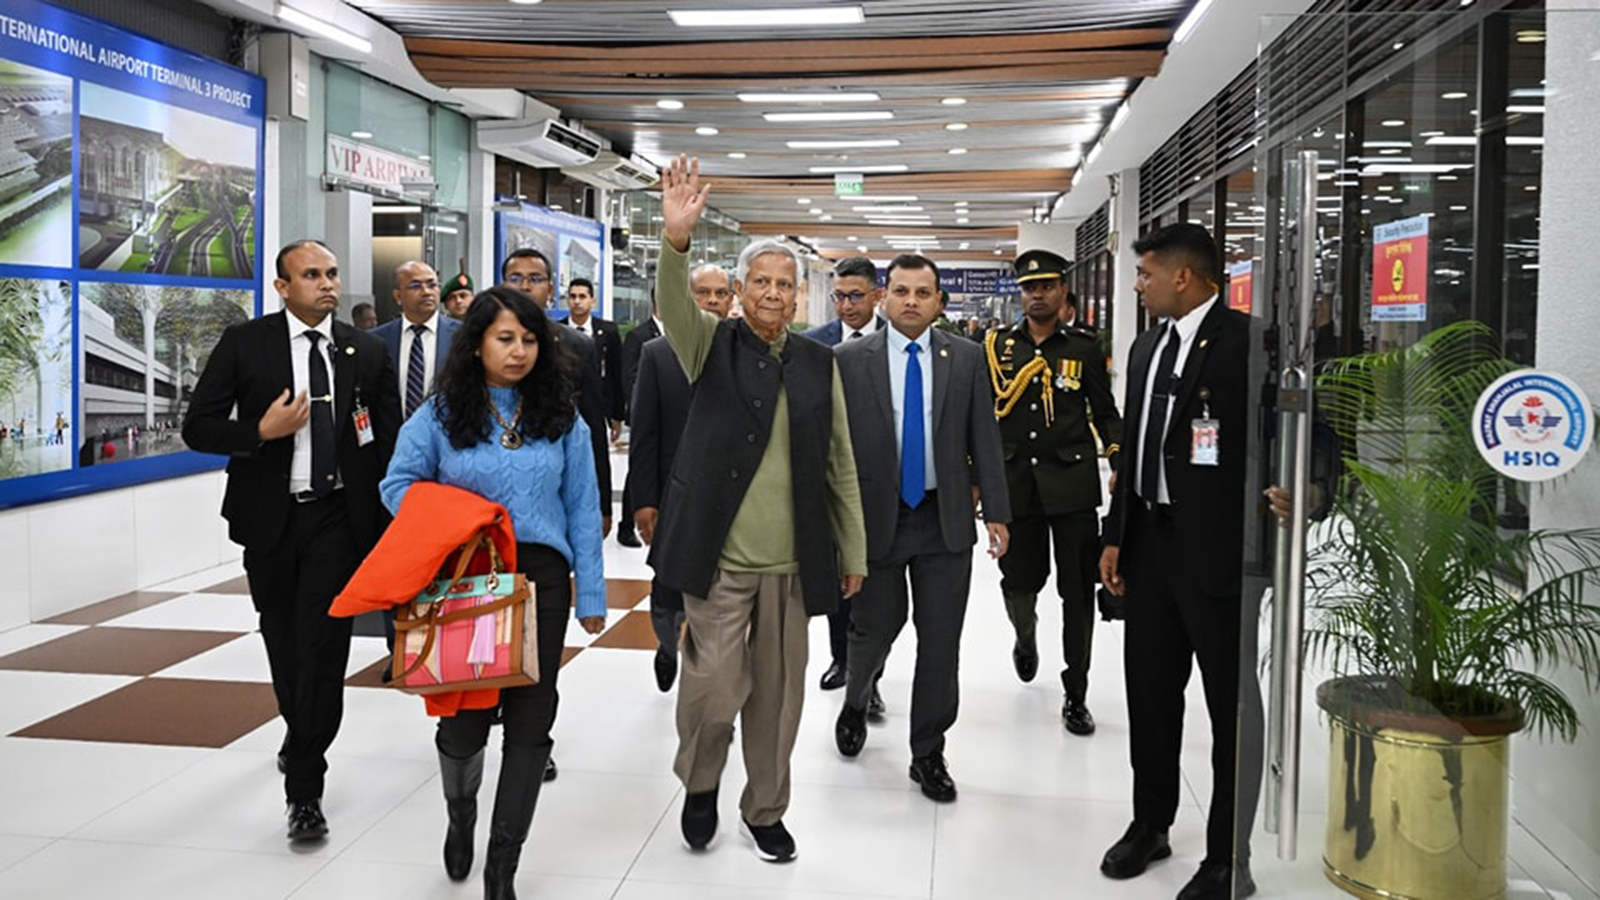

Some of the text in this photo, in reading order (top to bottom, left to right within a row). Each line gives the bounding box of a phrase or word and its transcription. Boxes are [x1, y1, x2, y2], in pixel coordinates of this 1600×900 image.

[98, 48, 150, 78] AIRPORT
[150, 65, 203, 95] TERMINAL
[204, 82, 211, 97] 3
[212, 84, 252, 109] PROJECT
[331, 144, 361, 173] VIP
